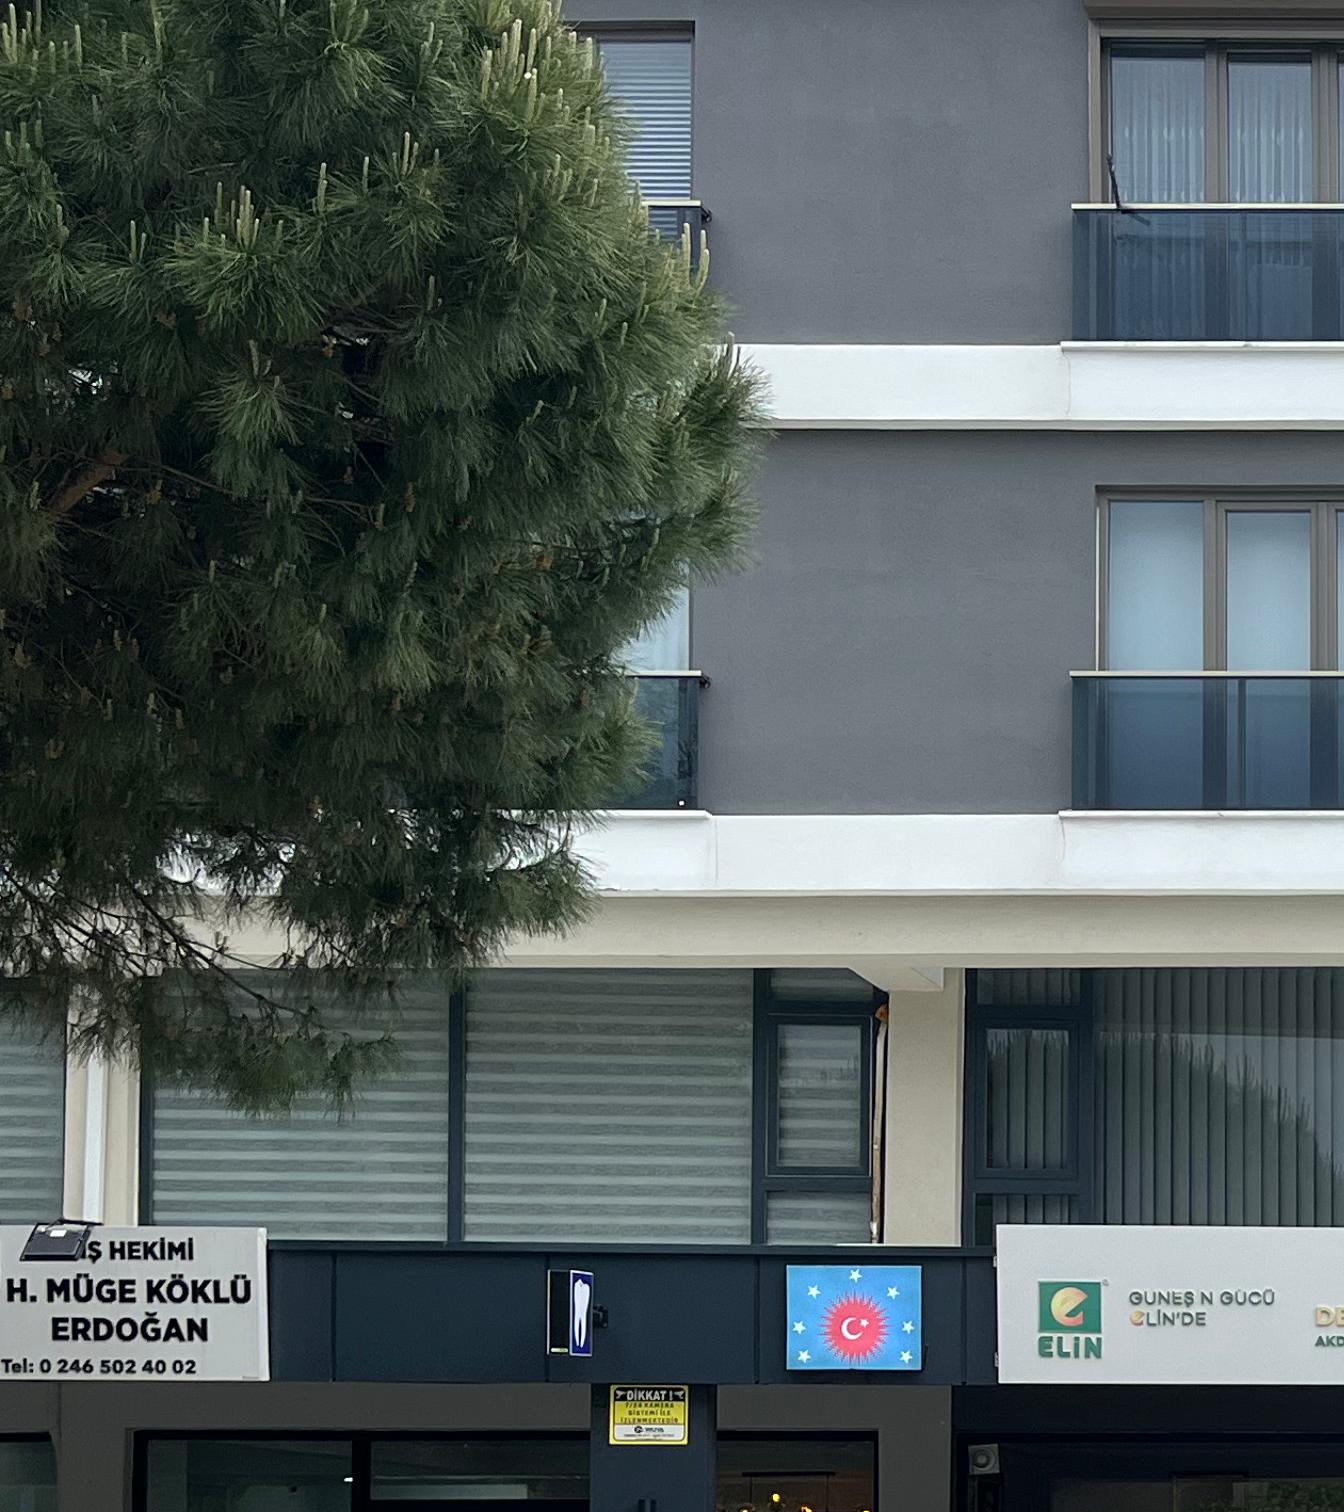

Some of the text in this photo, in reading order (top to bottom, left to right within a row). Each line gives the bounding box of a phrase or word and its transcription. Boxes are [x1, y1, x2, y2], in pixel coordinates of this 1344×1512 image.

[109, 1236, 194, 1261] HEKİMİ
[7, 1273, 251, 1305] H. MÜGE KÖKLÜ
[51, 1312, 208, 1342] ERDOĞAN
[1, 1358, 197, 1375] Tel: 0 246 502 40 02
[627, 1388, 667, 1401] DİKKAT
